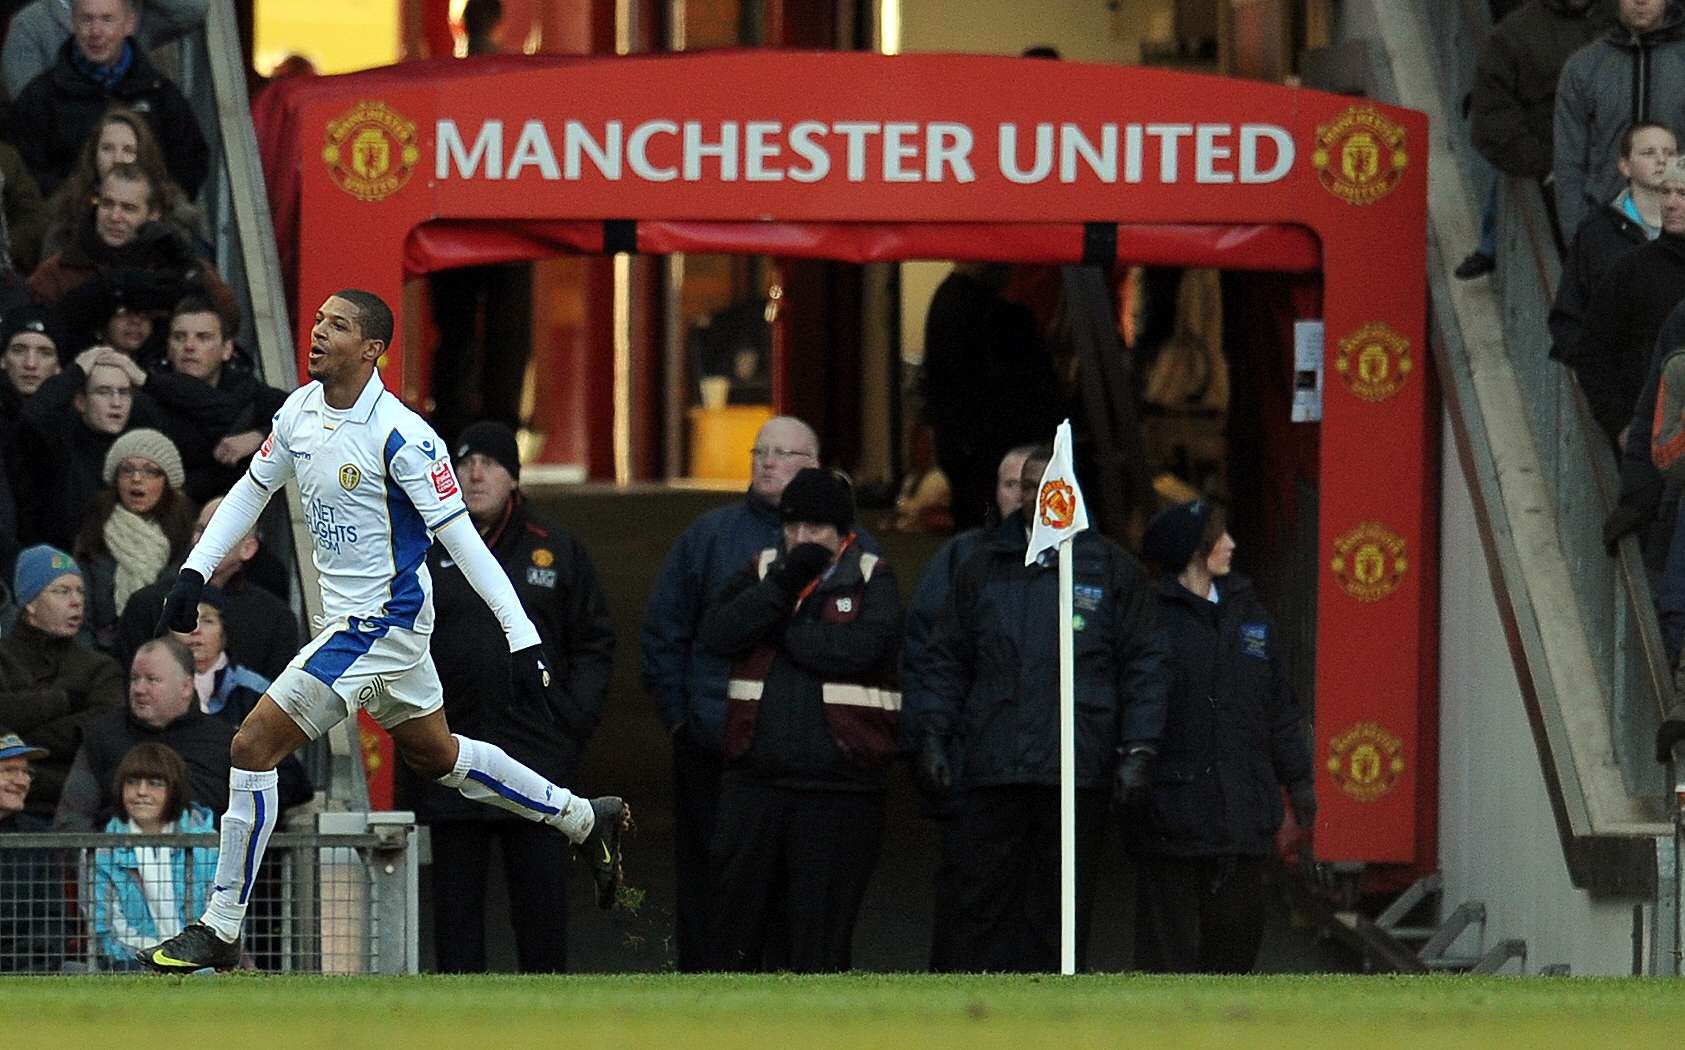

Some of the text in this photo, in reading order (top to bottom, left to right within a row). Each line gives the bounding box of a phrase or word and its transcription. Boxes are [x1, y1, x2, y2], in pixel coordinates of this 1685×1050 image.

[434, 119, 977, 184] MANCHESTER
[997, 122, 1297, 185] UNITED
[312, 498, 335, 524] NET
